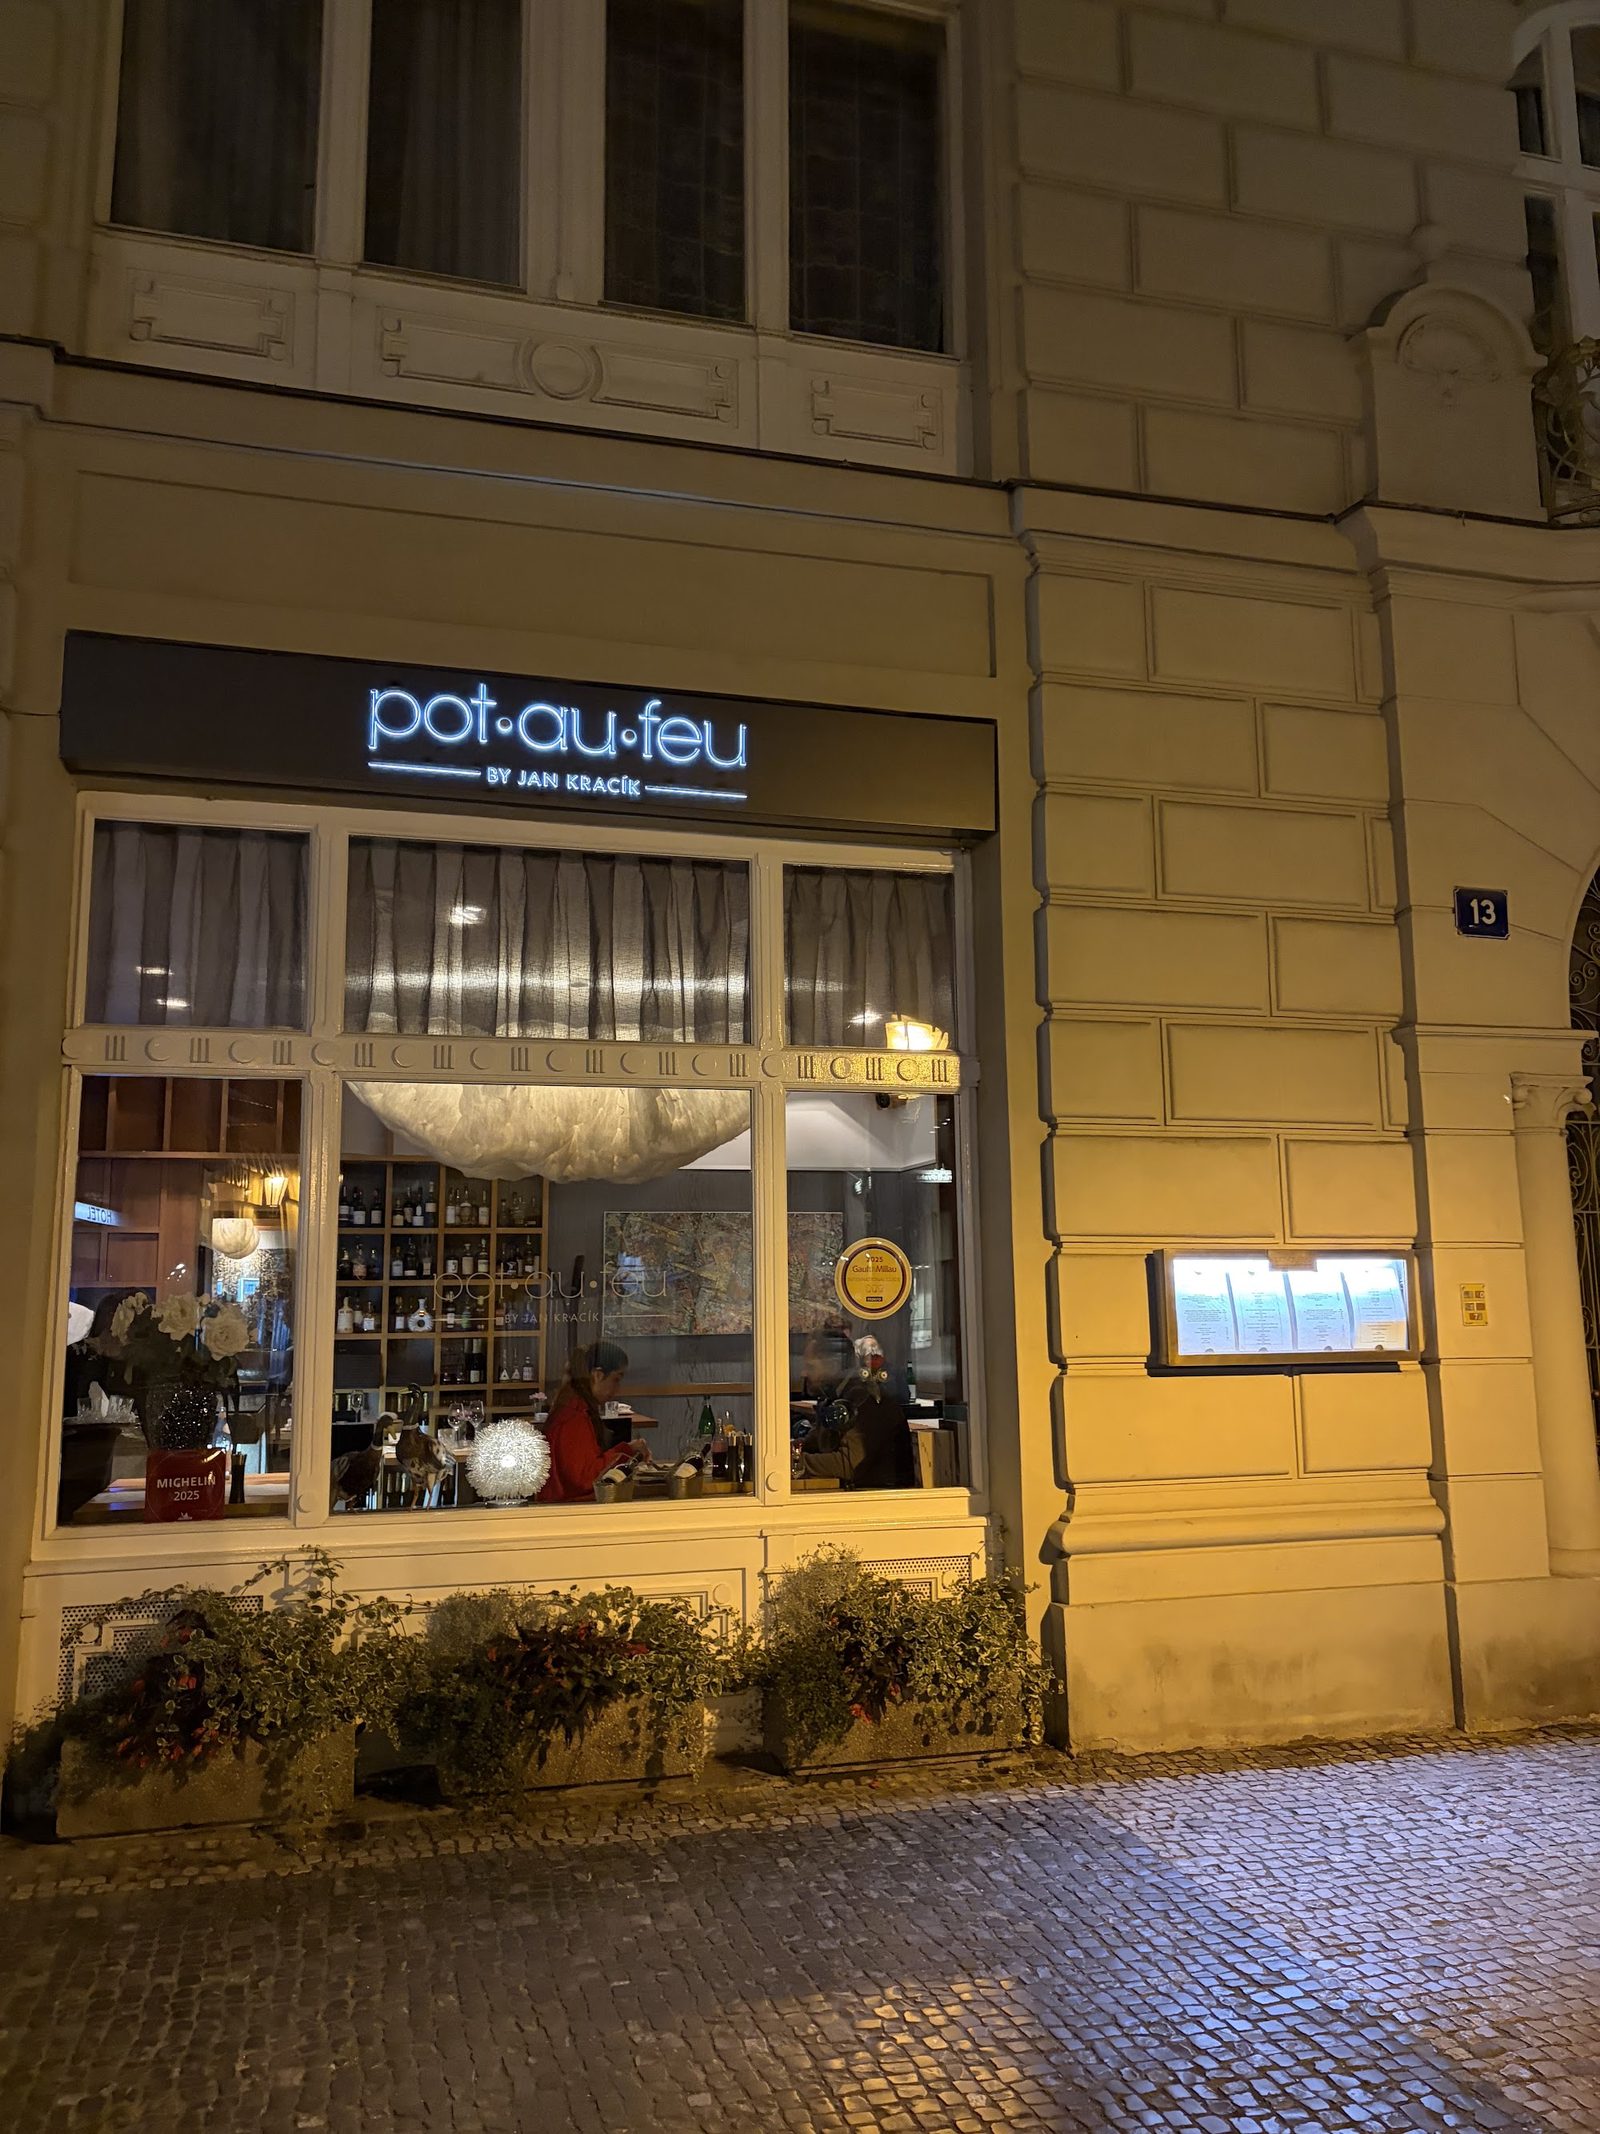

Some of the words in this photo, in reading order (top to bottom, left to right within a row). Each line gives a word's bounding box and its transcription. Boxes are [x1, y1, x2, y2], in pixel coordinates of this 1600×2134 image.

[487, 767, 511, 784] BY
[517, 769, 559, 788] JAN
[566, 774, 641, 796] KRACÍK
[1470, 898, 1496, 925] 13
[505, 1314, 518, 1324] BY
[157, 1476, 216, 1489] MICHELIN
[173, 1490, 200, 1501] 2025
